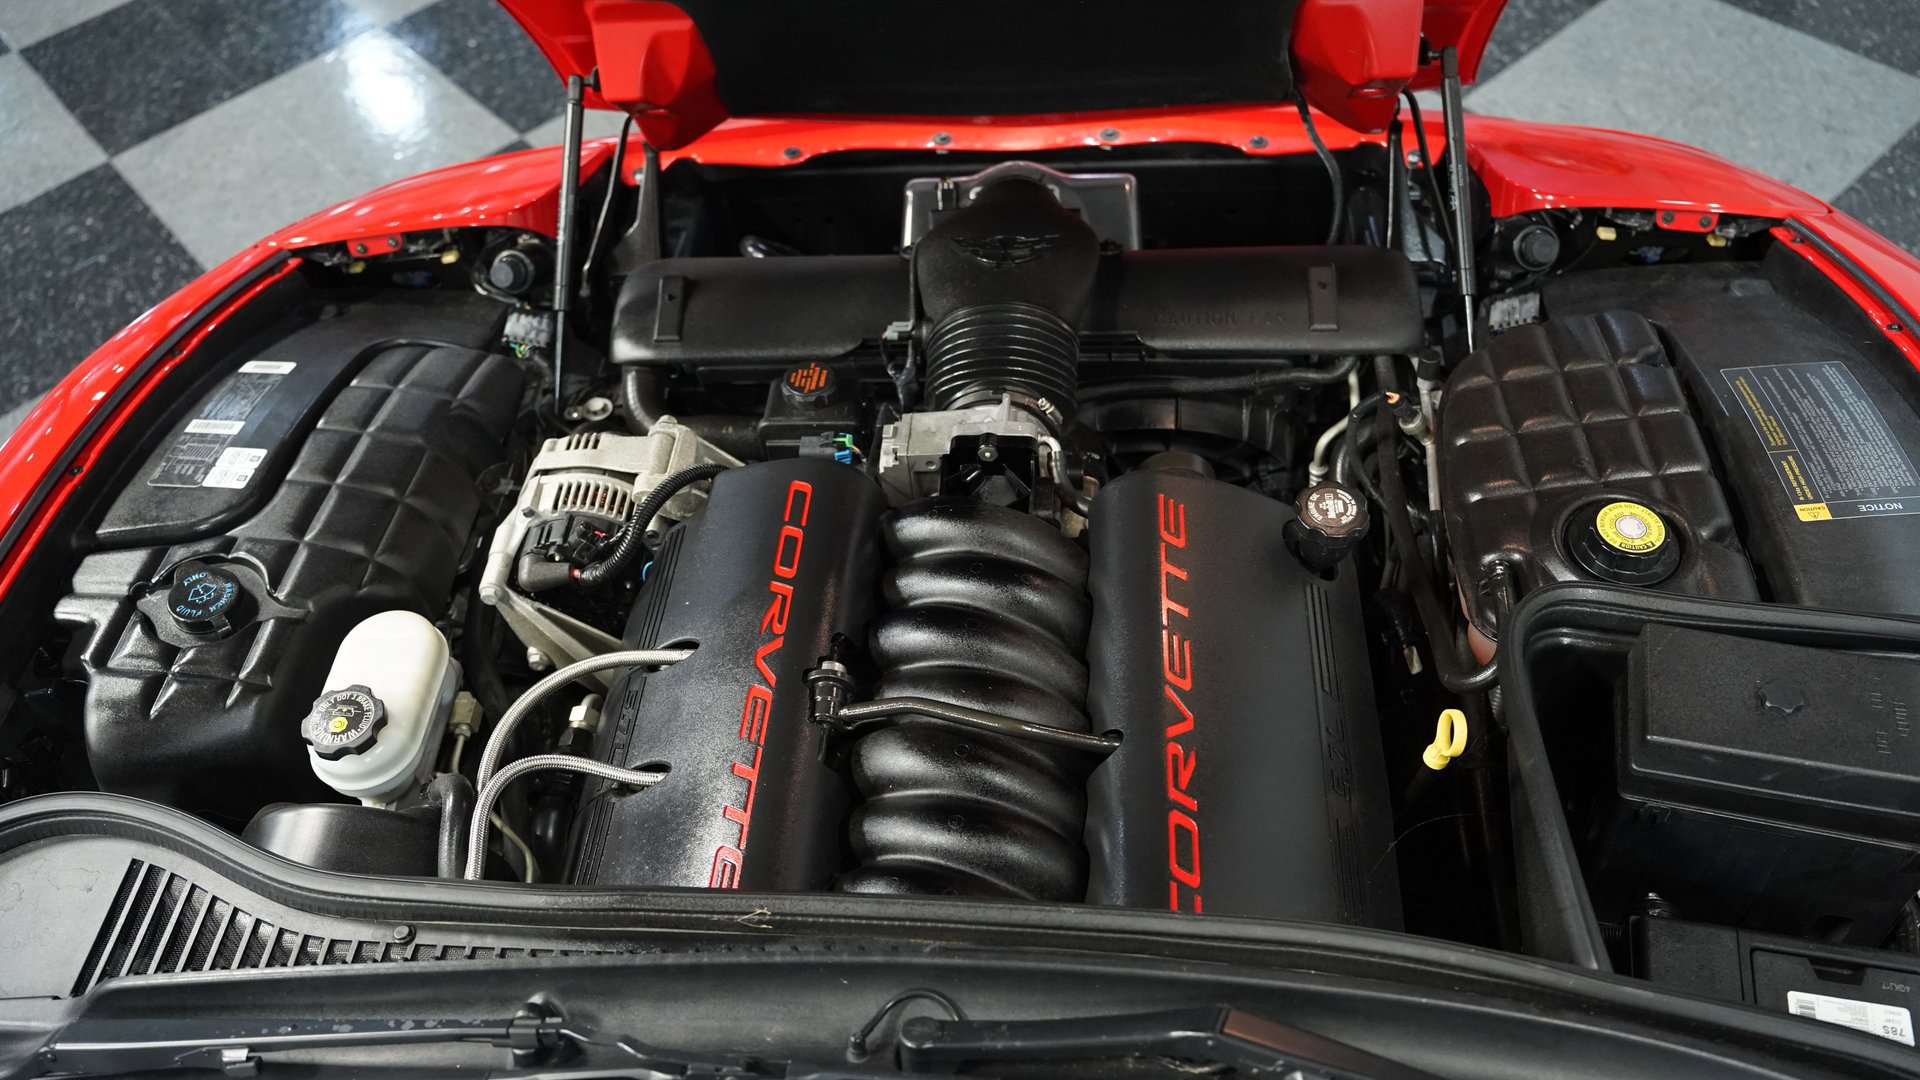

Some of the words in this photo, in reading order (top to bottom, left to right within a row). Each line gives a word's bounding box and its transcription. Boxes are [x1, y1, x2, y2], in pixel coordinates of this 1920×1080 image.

[1308, 501, 1323, 520] ENGINE
[1857, 502, 1904, 512] NOTICE
[1621, 542, 1648, 550] CAUTION
[183, 572, 207, 586] ONLY
[209, 582, 234, 612] WASHER
[176, 605, 203, 617] FLUID
[710, 480, 812, 889] CORVETTE
[337, 693, 350, 701] DOT
[356, 695, 371, 711] BRAKE
[359, 711, 372, 729] FLUID
[313, 727, 358, 745] WARNING
[1882, 1025, 1906, 1037] 78S
